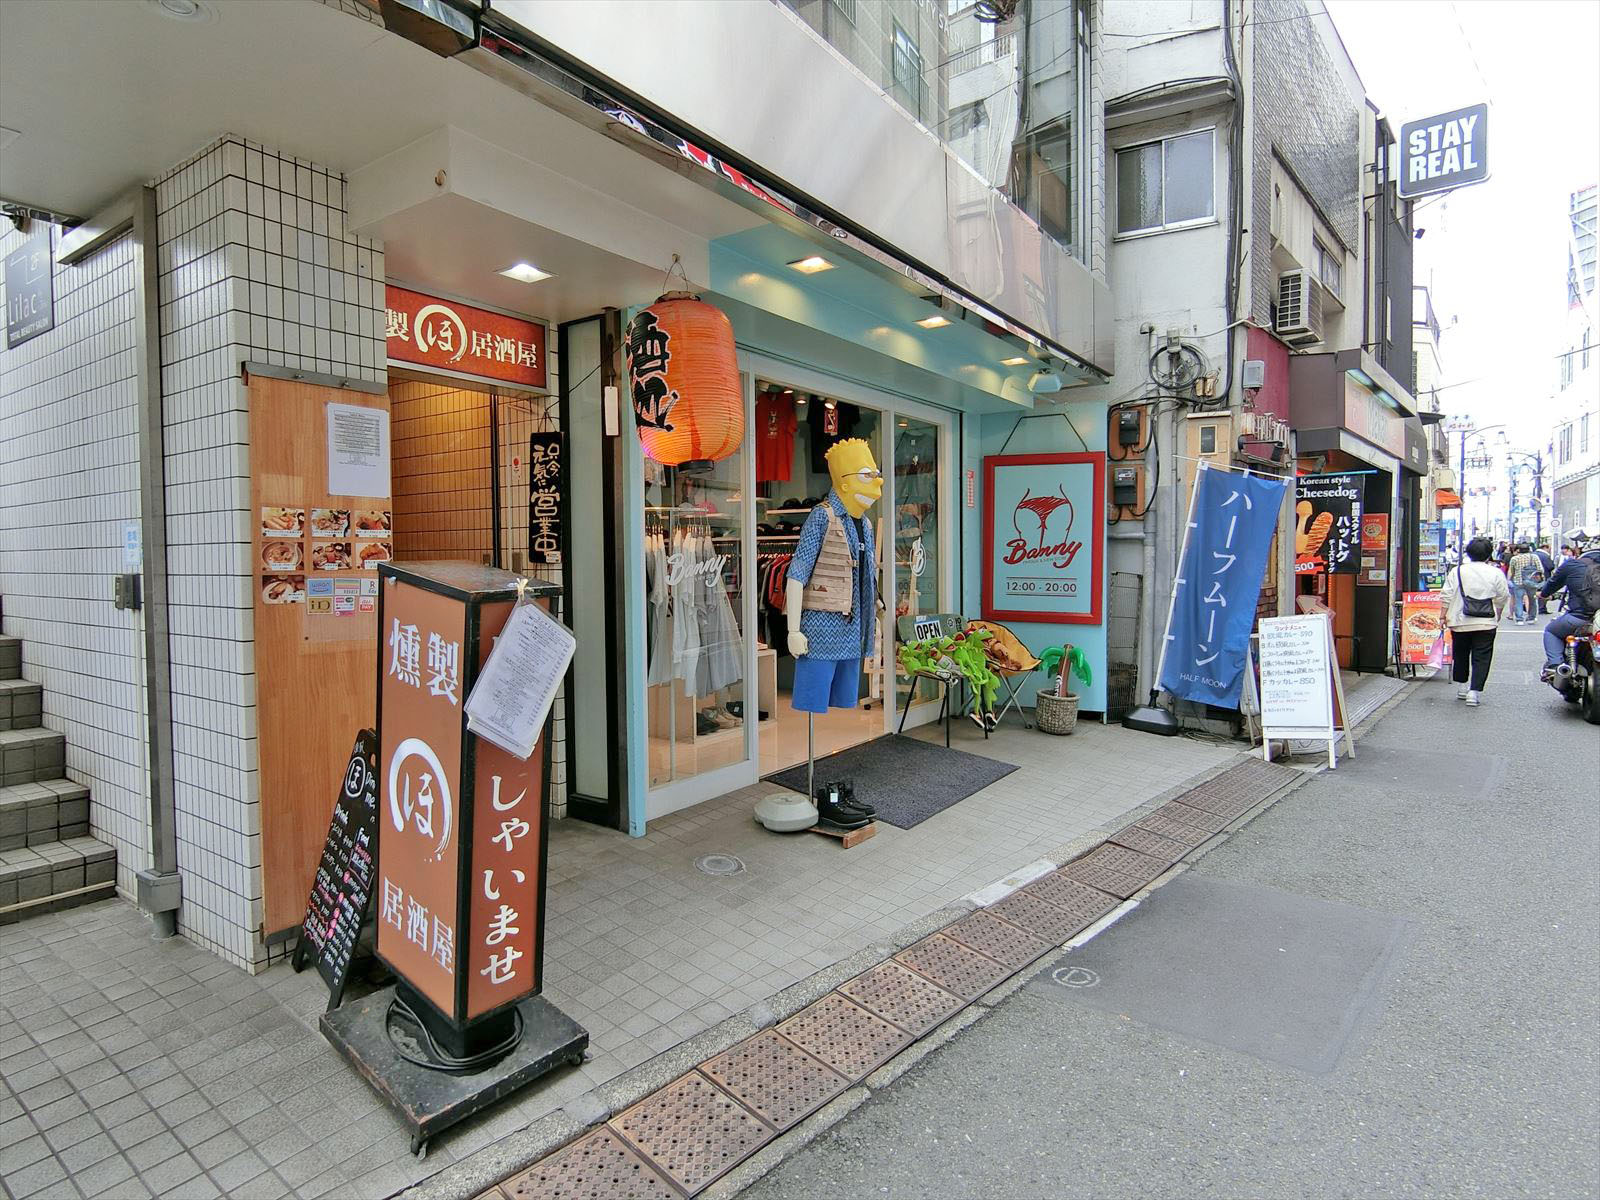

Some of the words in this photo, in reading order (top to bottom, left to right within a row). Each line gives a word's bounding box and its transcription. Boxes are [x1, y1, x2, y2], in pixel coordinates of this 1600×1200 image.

[1409, 114, 1478, 155] STAY
[1409, 143, 1478, 182] REAL
[9, 293, 37, 326] Lilac
[471, 330, 538, 368] 居酒屋
[532, 444, 550, 487] 元気に
[1300, 477, 1329, 485] Korean
[1331, 475, 1351, 486] style
[1295, 486, 1358, 500] Cheesedog
[531, 485, 560, 555] 営業中
[1003, 539, 1082, 569] Banny
[1336, 516, 1351, 563] ハットグ
[1195, 490, 1252, 666] ハーフムーン
[1295, 561, 1314, 572] 500
[1006, 581, 1036, 591] 12:00
[1045, 582, 1077, 592] 20:00
[916, 621, 941, 640] OPEN
[389, 617, 459, 706] 燻製
[1180, 672, 1200, 683] HALF
[1201, 677, 1227, 689] MOON
[382, 876, 454, 974] 居酒屋
